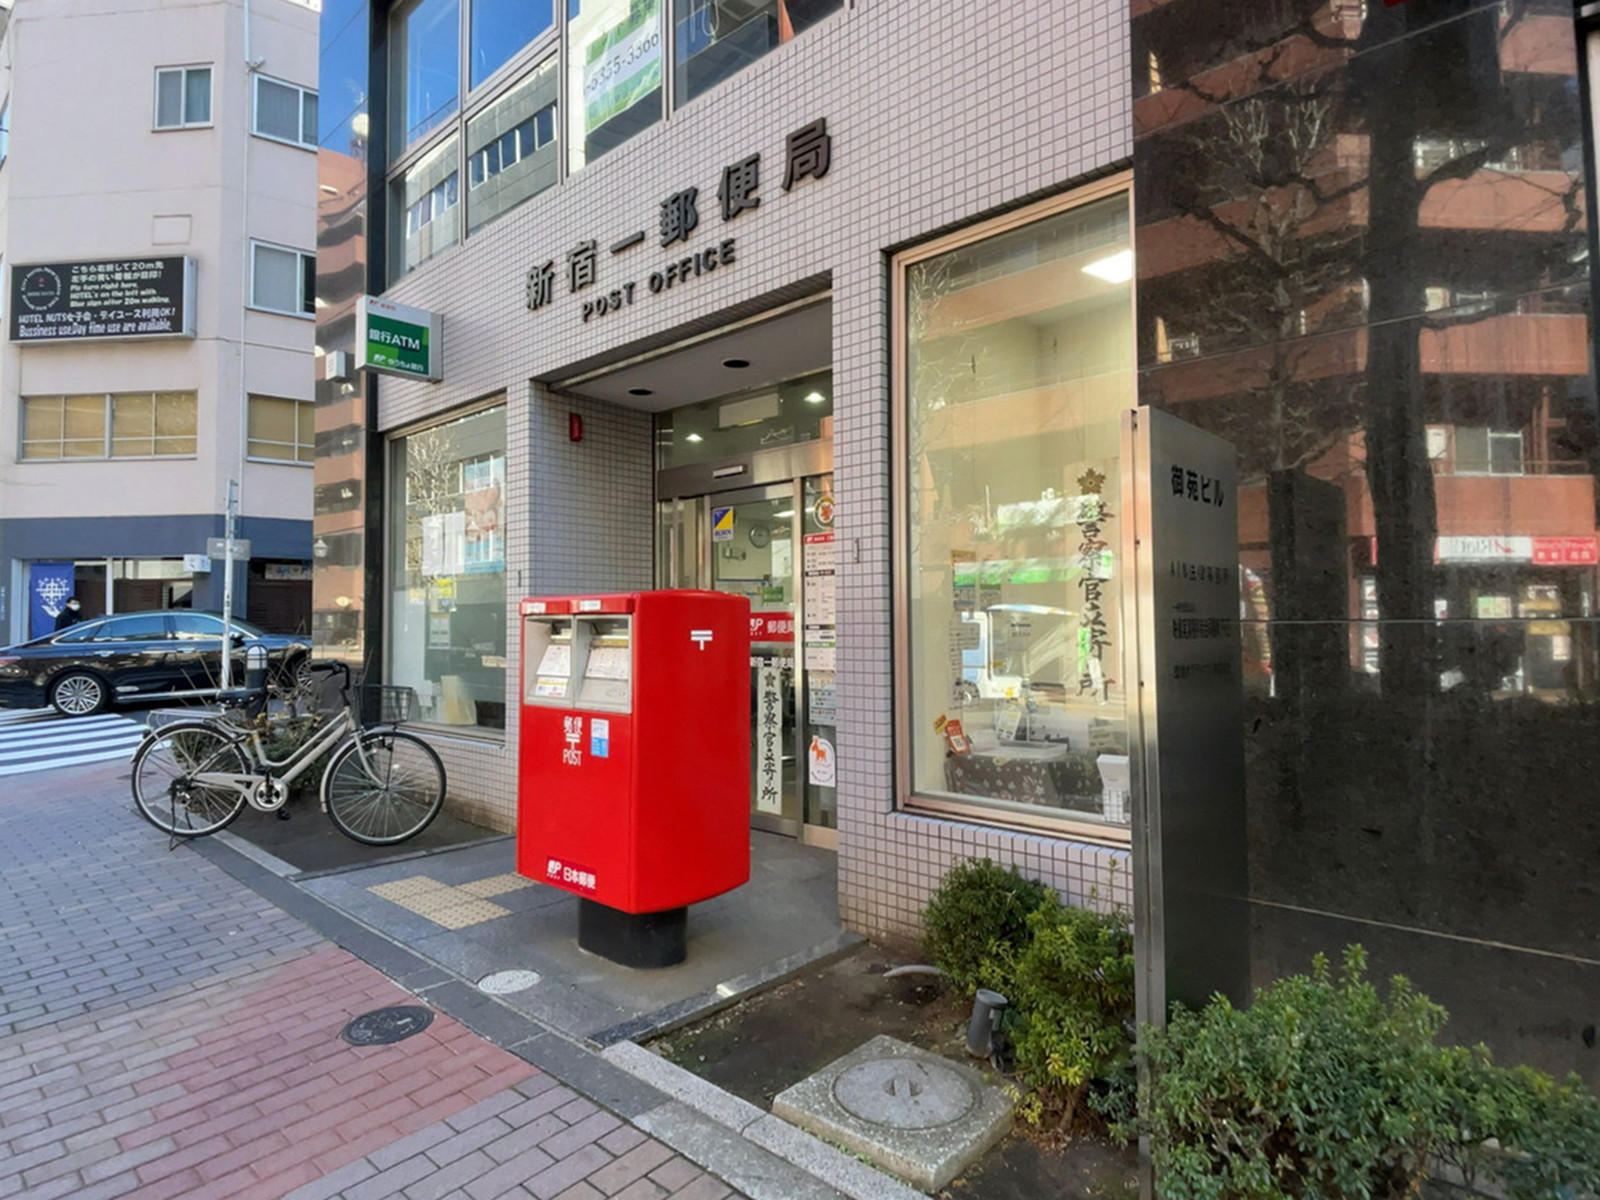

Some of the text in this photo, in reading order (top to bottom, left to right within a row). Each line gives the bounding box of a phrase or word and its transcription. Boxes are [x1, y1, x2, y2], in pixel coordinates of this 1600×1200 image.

[526, 117, 832, 311] 新宿一郵便局
[582, 238, 736, 322] POST OFFICE
[18, 314, 44, 324] HOTEL
[107, 323, 121, 333] use
[122, 322, 136, 332] are
[369, 328, 420, 350] 銀行ATM
[1171, 464, 1224, 508] 御苑ビル
[564, 715, 582, 735] 郵便
[563, 748, 582, 766] POST
[563, 866, 596, 890] 日本郵便
